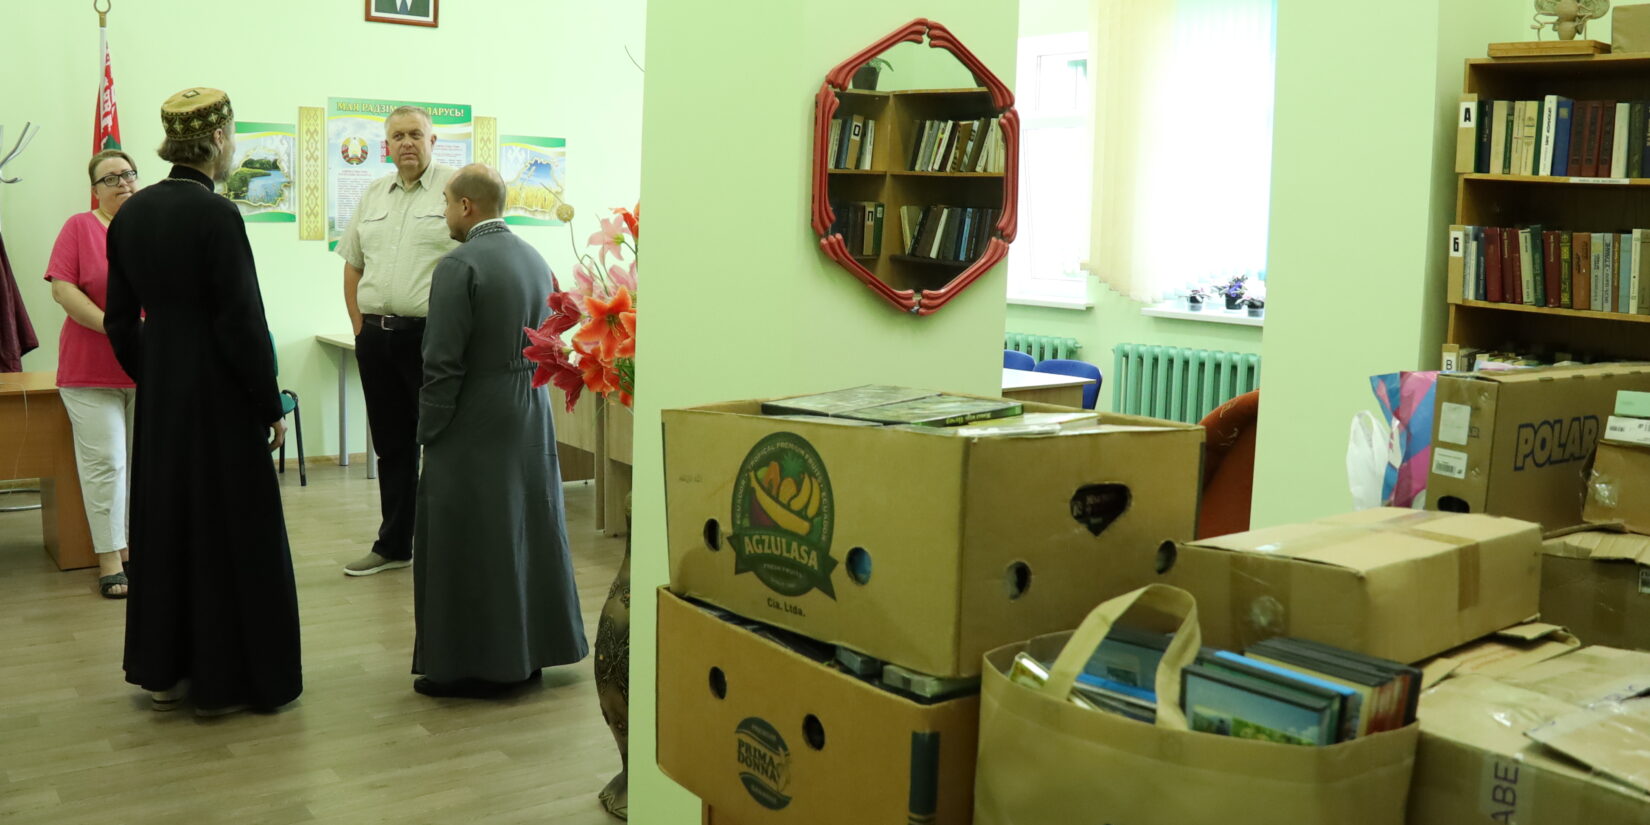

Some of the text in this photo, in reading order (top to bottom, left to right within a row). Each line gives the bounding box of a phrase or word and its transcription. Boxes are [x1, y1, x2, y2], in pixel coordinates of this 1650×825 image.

[336, 101, 464, 117] МАЯ РАДЗІМ ЛАРУСЬ!
[1463, 107, 1472, 123] А
[1453, 236, 1460, 252] Б
[744, 535, 818, 571] AGZULASA
[737, 738, 777, 771] PRIMA
[737, 751, 780, 783] DONNA
